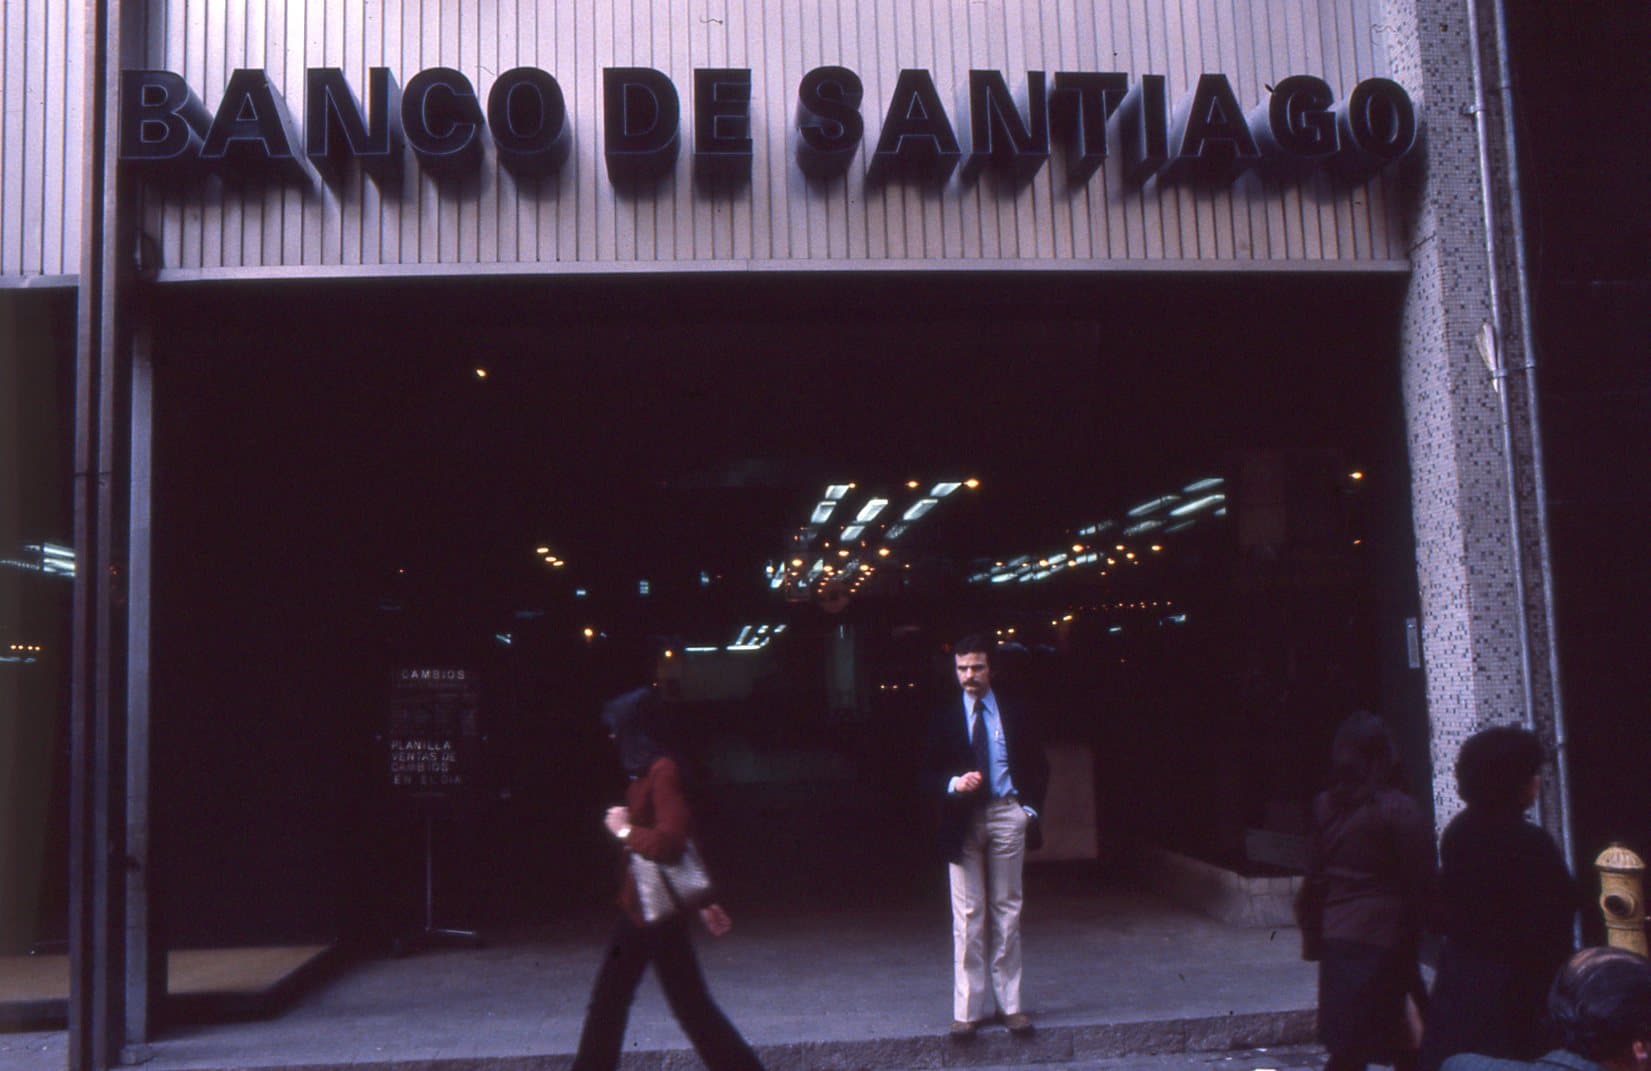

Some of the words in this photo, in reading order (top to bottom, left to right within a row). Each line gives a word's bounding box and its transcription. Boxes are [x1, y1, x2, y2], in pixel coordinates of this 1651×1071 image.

[118, 67, 566, 160] BANCO
[603, 67, 752, 155] DE
[799, 66, 1417, 159] SANTIAGO
[402, 669, 465, 680] CAMBIOS
